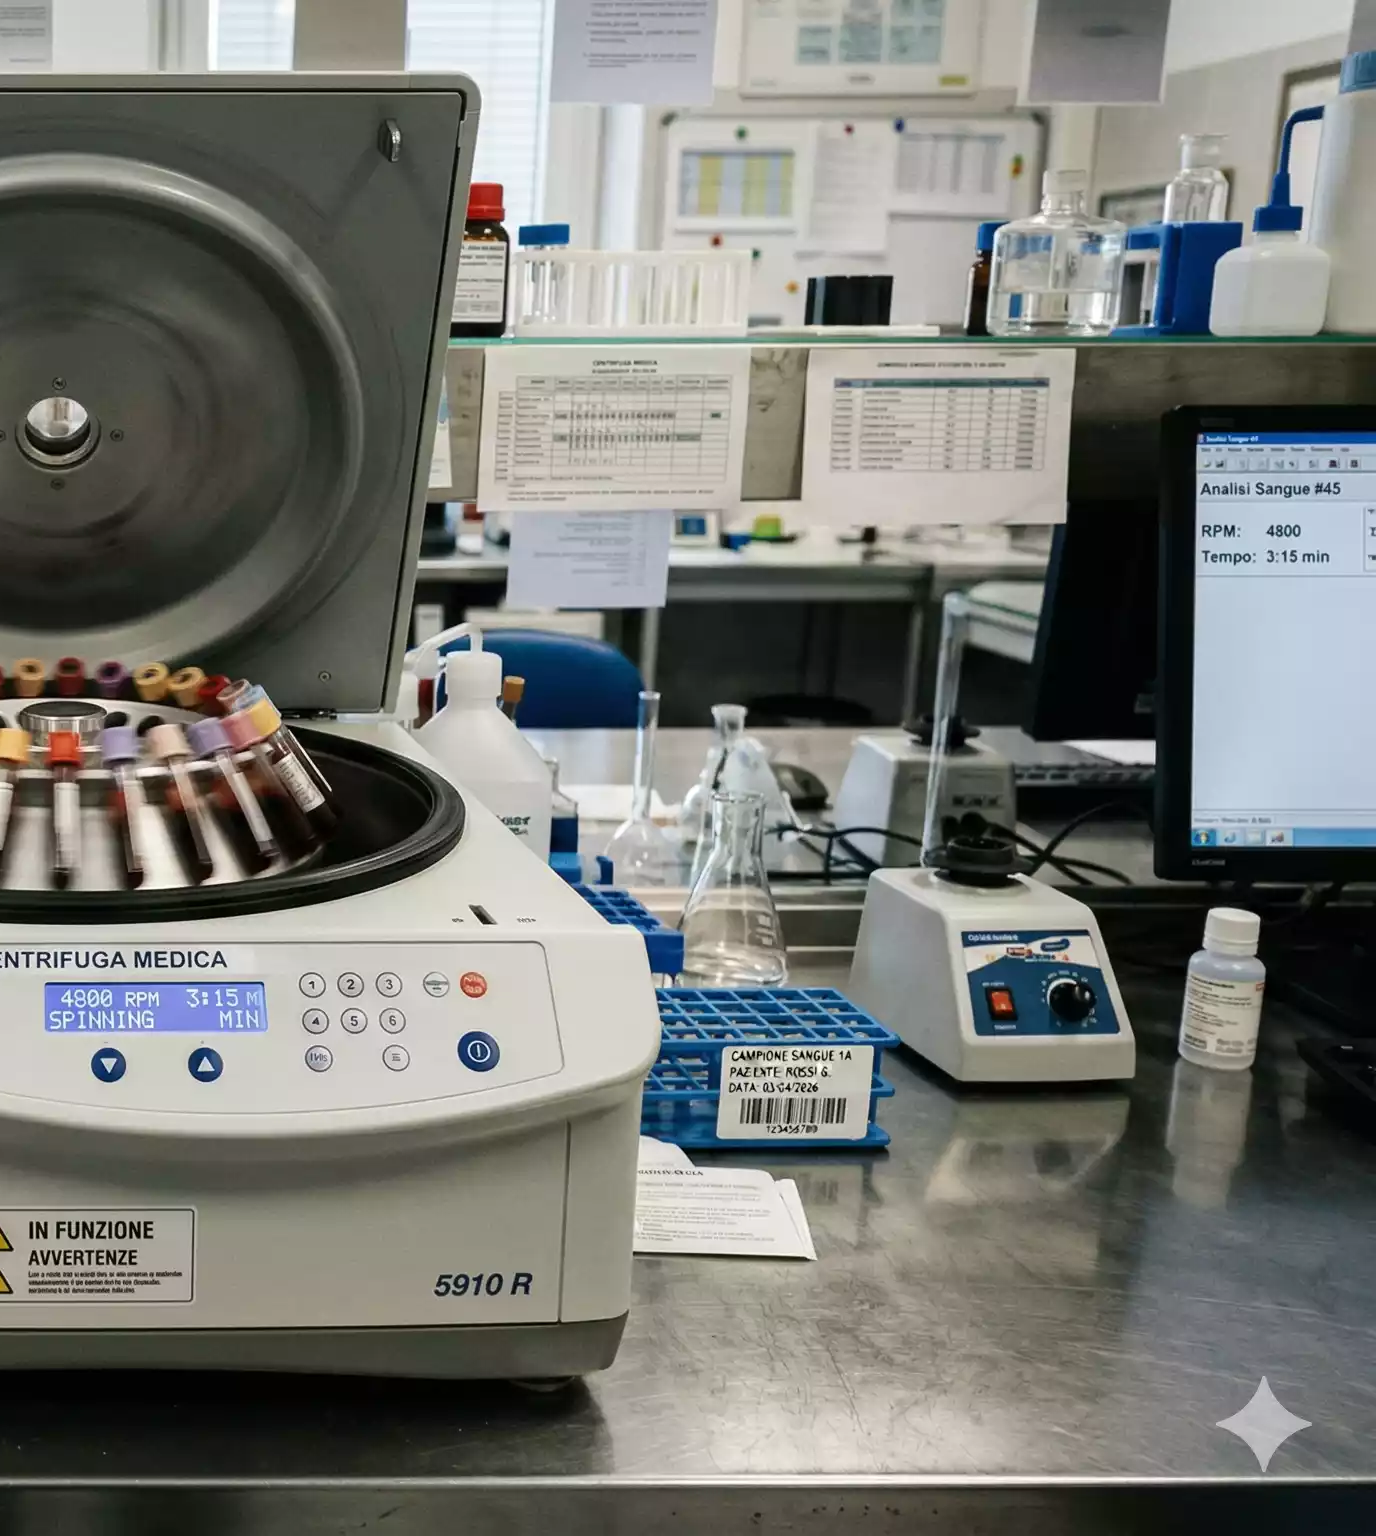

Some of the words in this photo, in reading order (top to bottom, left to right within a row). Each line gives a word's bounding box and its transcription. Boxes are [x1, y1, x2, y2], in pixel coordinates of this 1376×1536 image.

[1200, 482, 1251, 495] Analisi
[1255, 482, 1310, 498] Sangue
[1314, 482, 1341, 495] #45
[1201, 525, 1241, 538] RPM:
[1266, 524, 1301, 538] 4800
[1201, 550, 1257, 566] Tempo:
[1266, 550, 1298, 563] 3:15
[1302, 550, 1330, 563] min
[134, 950, 228, 969] MEDICA
[308, 980, 316, 990] 1
[346, 979, 356, 990] 2
[385, 979, 394, 990] 3
[60, 988, 113, 1008] 4800
[125, 992, 160, 1008] RPM
[186, 988, 239, 1008] 3:15
[49, 1010, 154, 1029] SPINNING
[219, 1010, 260, 1029] MIN
[311, 1016, 320, 1026] 4
[350, 1015, 359, 1027] 5
[388, 1015, 397, 1026] 6
[731, 1050, 788, 1062] CAMPIONE
[791, 1050, 835, 1062] SANGUE
[838, 1050, 852, 1061] 1A
[28, 1221, 48, 1239] IN
[55, 1221, 154, 1239] FUNZIONE
[28, 1250, 138, 1266] AVVERTENZE
[434, 1273, 503, 1297] 5910
[510, 1272, 533, 1296] R
